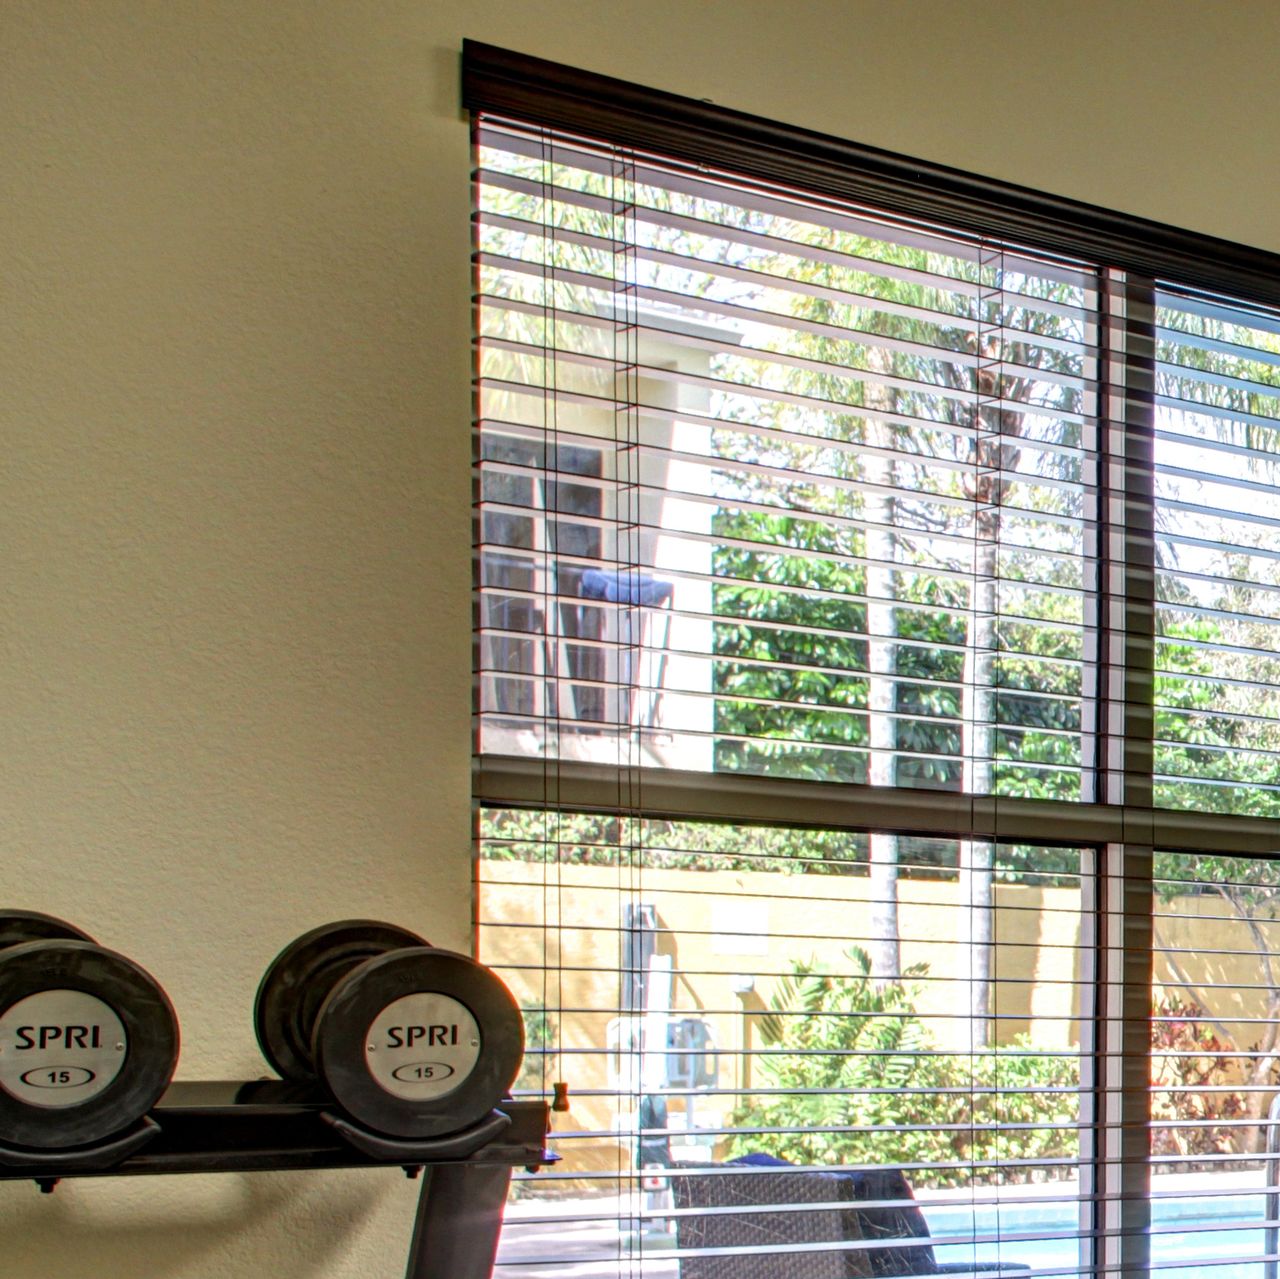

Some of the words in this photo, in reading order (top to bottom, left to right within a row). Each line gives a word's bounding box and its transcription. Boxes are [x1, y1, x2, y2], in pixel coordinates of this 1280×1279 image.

[15, 1025, 100, 1050] SPRI
[387, 1024, 458, 1048] SPRI
[48, 1072, 70, 1083] 15
[415, 1067, 433, 1078] 15
